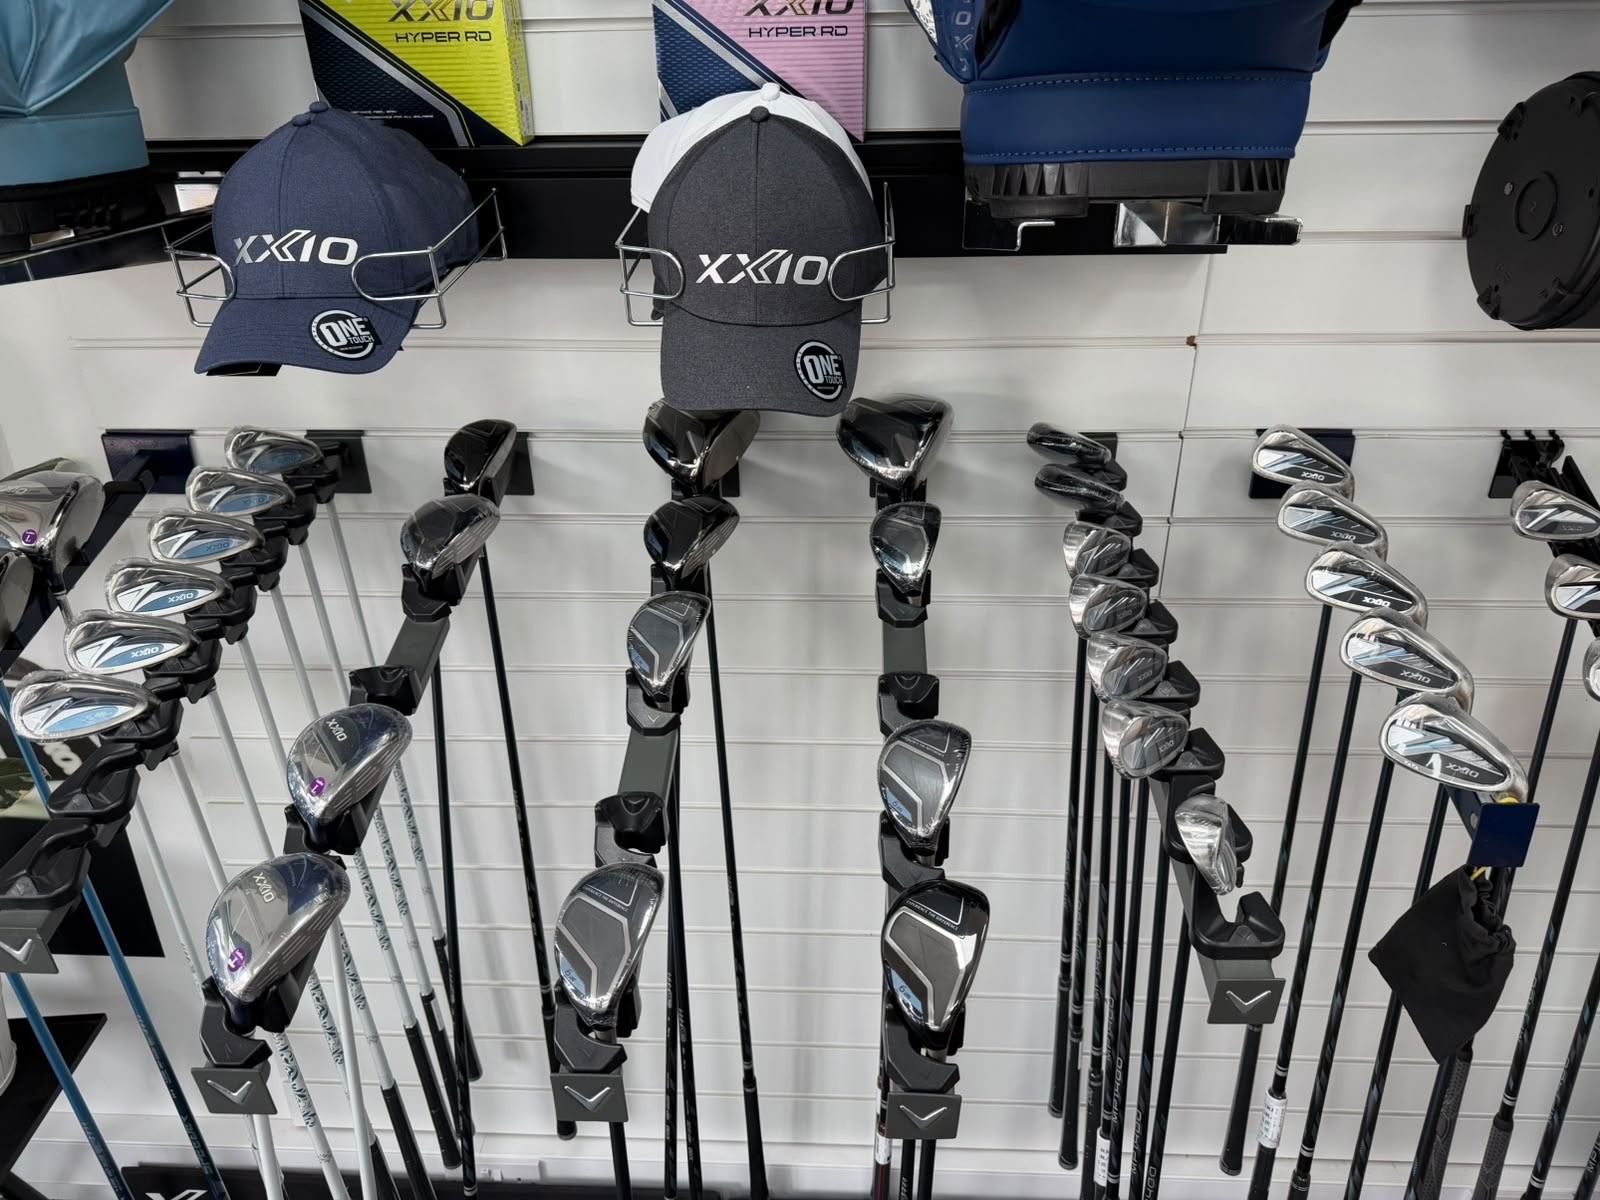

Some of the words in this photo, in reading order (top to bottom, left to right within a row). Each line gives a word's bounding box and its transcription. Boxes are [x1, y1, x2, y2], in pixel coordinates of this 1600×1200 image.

[395, 31, 461, 43] HYPER
[465, 30, 492, 42] RD
[748, 26, 816, 38] HYPER
[820, 25, 848, 37] RD
[233, 229, 359, 267] XXIO
[695, 249, 829, 286] XXIO
[319, 317, 371, 347] ONE
[347, 335, 375, 345] TOUCH
[803, 354, 842, 384] ONE
[824, 375, 844, 385] TOUCH
[253, 872, 275, 903] XXIO
[1112, 1056, 1123, 1123] MP1400
